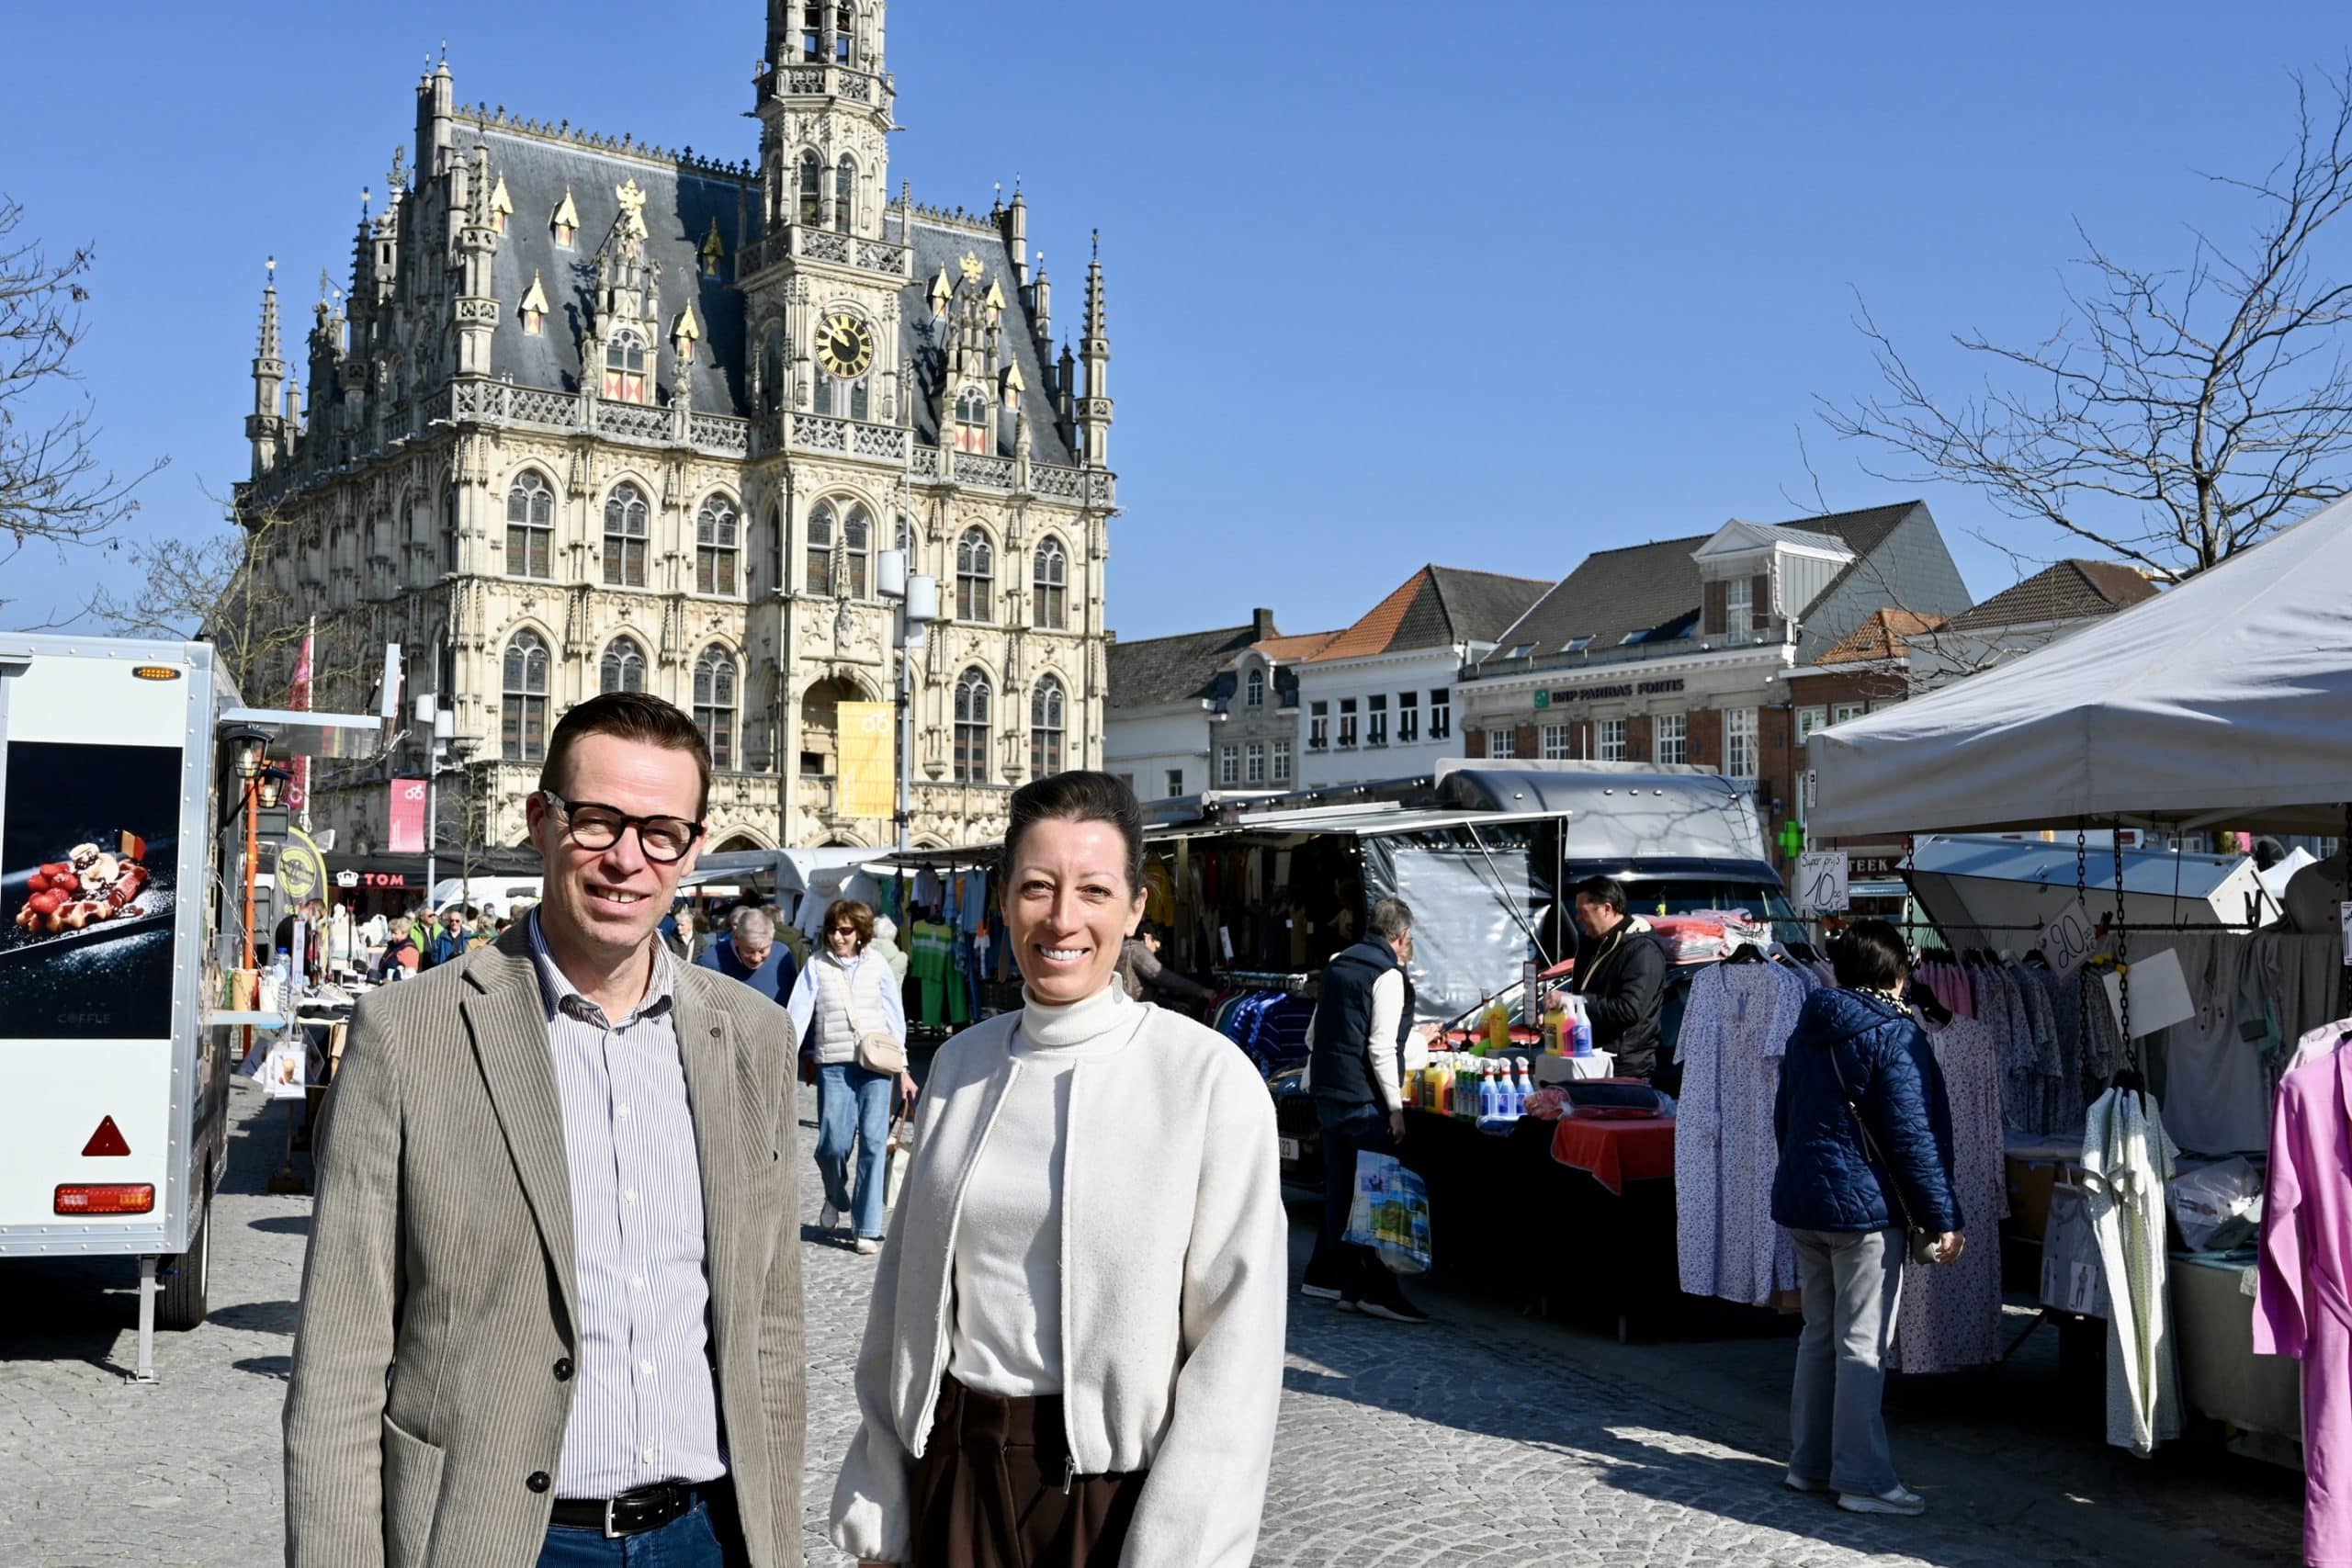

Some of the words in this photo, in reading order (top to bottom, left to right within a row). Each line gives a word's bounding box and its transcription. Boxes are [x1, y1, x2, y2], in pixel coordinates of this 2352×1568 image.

[1551, 690, 1578, 704] BNP
[1579, 684, 1633, 701] PARIBAS
[1637, 678, 1685, 695] FORTIS
[364, 874, 404, 886] TOM
